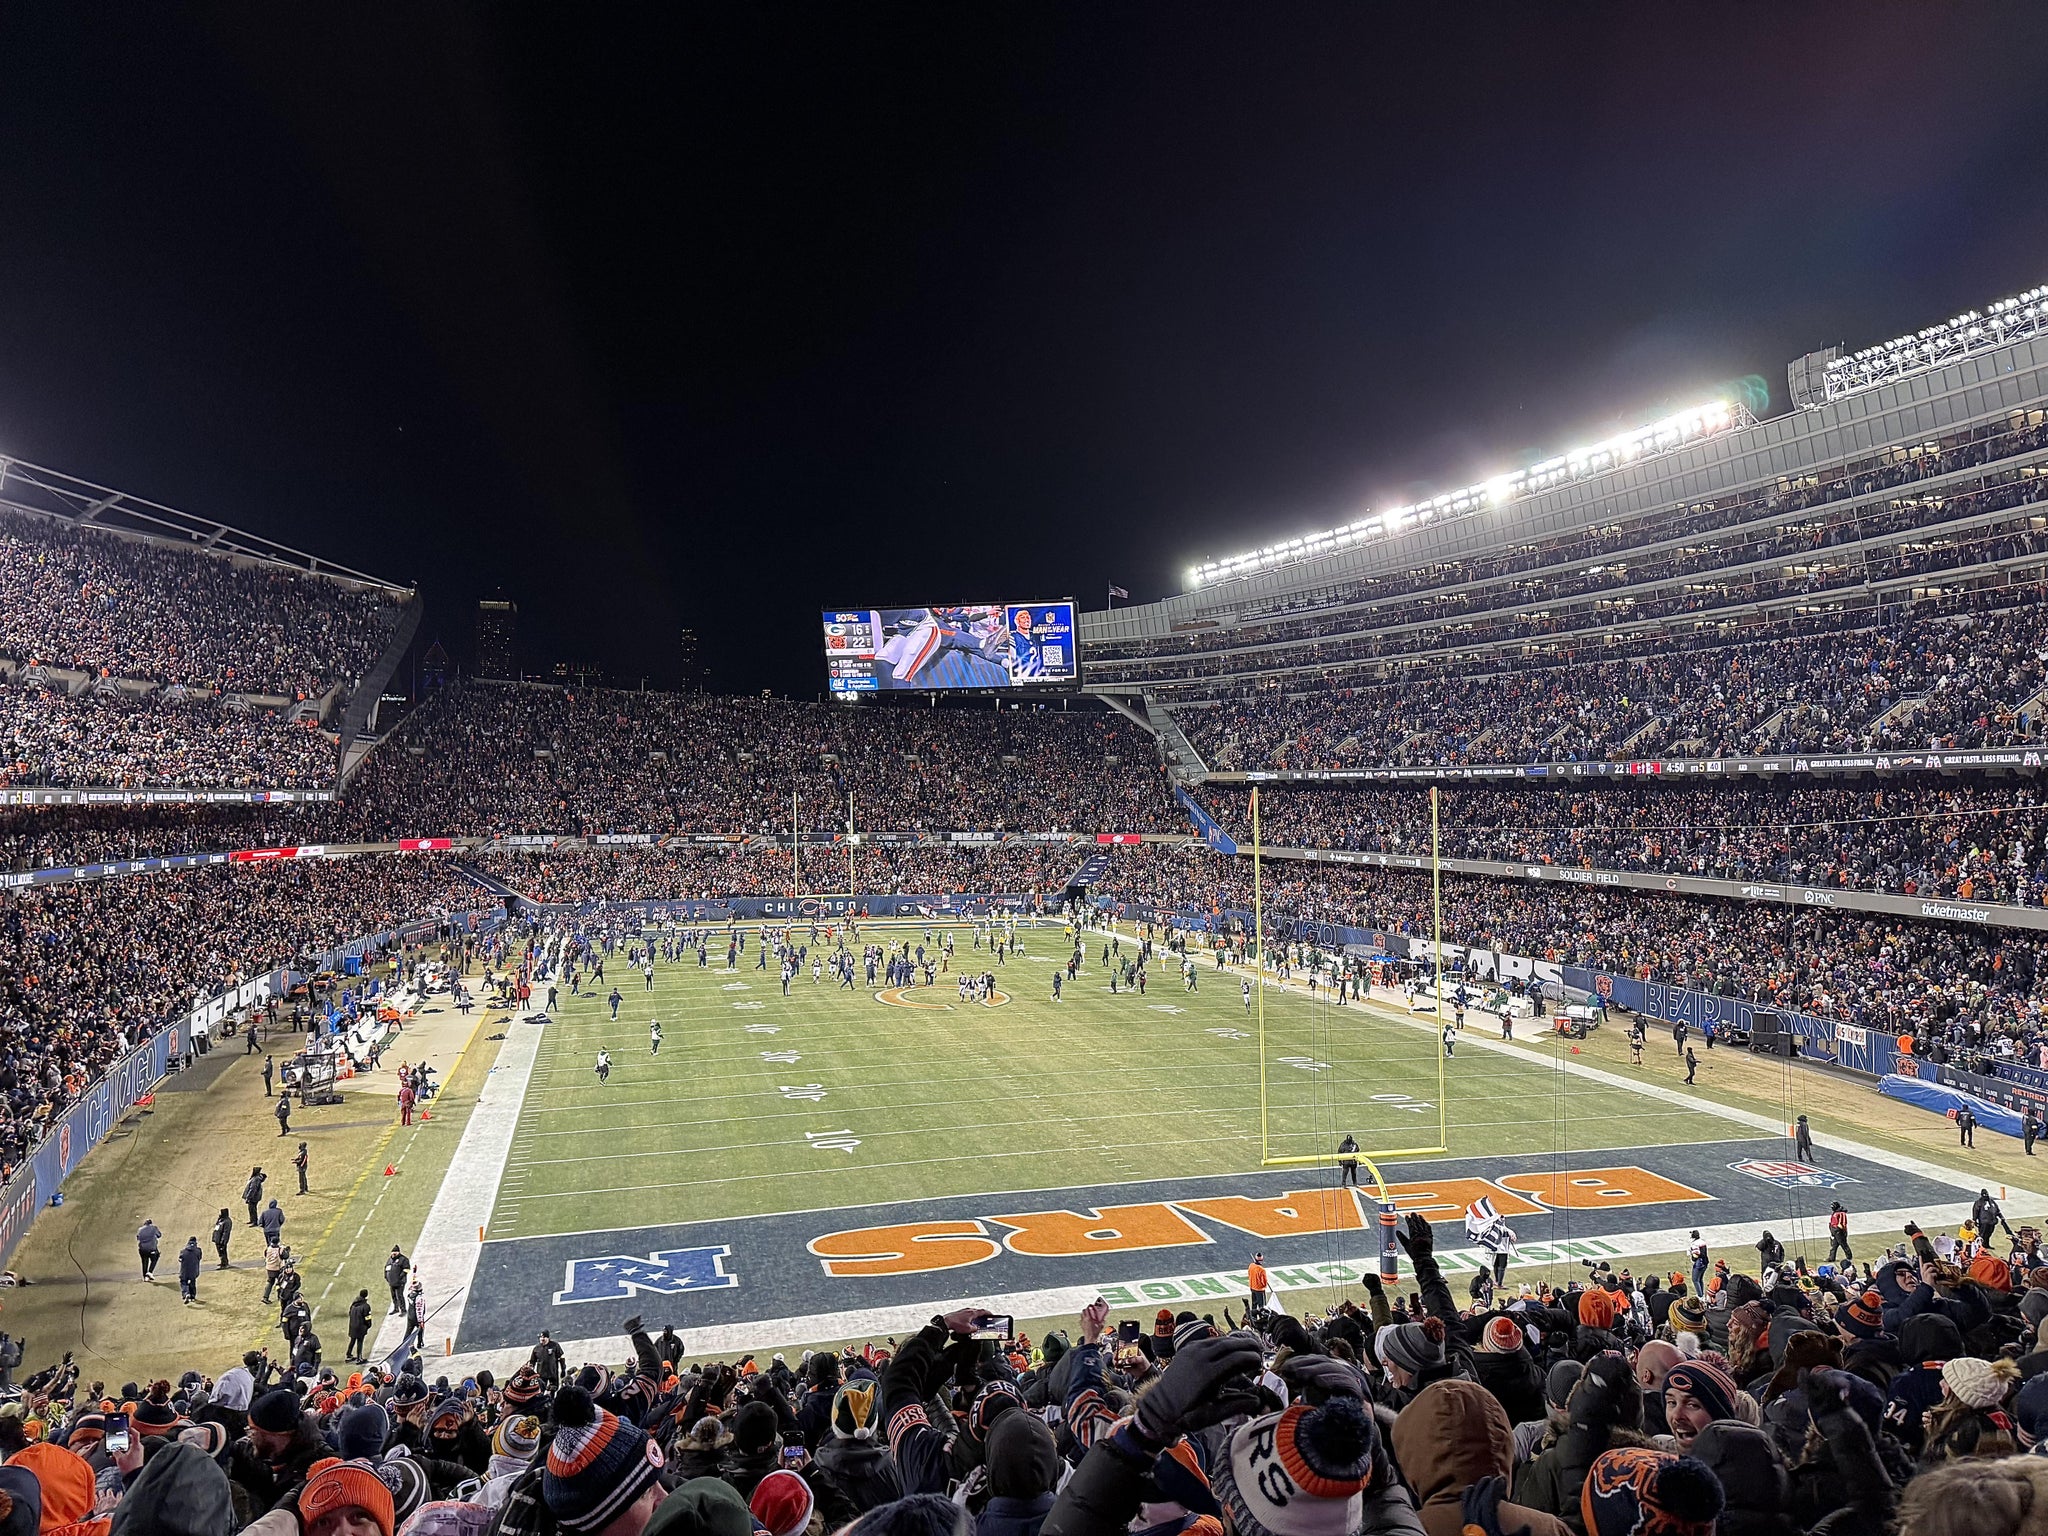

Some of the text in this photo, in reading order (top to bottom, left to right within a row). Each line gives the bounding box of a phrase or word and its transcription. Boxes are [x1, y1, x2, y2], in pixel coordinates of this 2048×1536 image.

[851, 624, 863, 635] 16
[852, 637, 866, 648] 22
[1573, 765, 1581, 774] 16
[1614, 764, 1624, 774] 22
[1666, 762, 1684, 773] 4:50
[597, 834, 650, 843] DOWN
[951, 832, 994, 841] BEAR
[1559, 870, 1619, 884] SOLDIER FIELD
[1750, 886, 1763, 897] Lite
[1815, 892, 1835, 904] PNC
[1921, 902, 1990, 921] ticketmaster
[1649, 984, 1721, 1029] BEAR
[760, 1050, 802, 1062] 30
[1277, 1056, 1333, 1069] 20
[86, 1040, 157, 1151] CHICAGO
[778, 1083, 828, 1099] 20
[2011, 1087, 2046, 1102] RETIRED
[1370, 1094, 1437, 1110] 10
[805, 1129, 862, 1149] 10
[806, 1166, 1720, 1278] BEARS
[1883, 1401, 1907, 1426] 34
